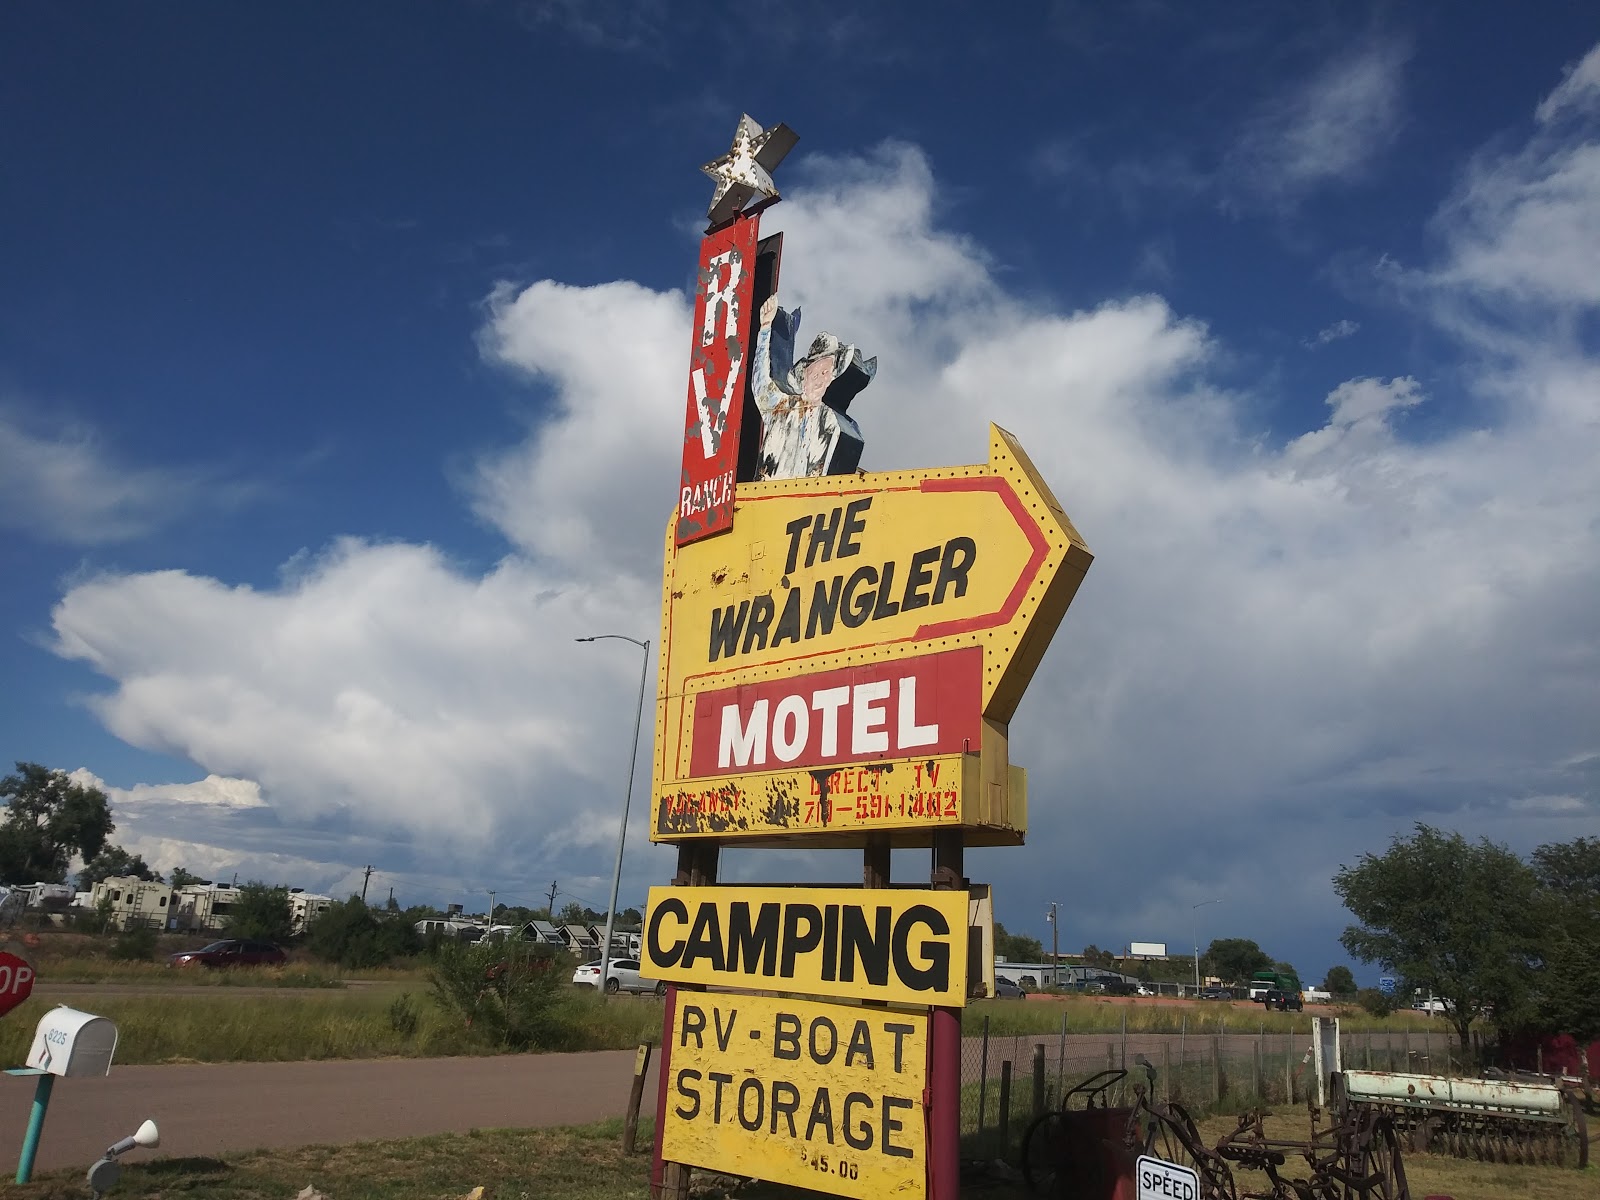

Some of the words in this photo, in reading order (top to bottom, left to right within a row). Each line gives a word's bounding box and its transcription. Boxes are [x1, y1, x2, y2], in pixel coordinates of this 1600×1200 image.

[692, 250, 744, 459] RV
[680, 470, 733, 518] RANCH
[785, 497, 873, 575] THE
[708, 536, 977, 662] WRANGLER
[717, 676, 939, 768] MOTEL
[810, 767, 882, 795] DRECT
[914, 763, 940, 788] TV
[647, 898, 951, 993] CAMPING
[680, 1005, 737, 1052] RV
[773, 1013, 915, 1074] BOAT
[675, 1069, 914, 1159] STORAGE
[1142, 1171, 1194, 1200] SPEED
